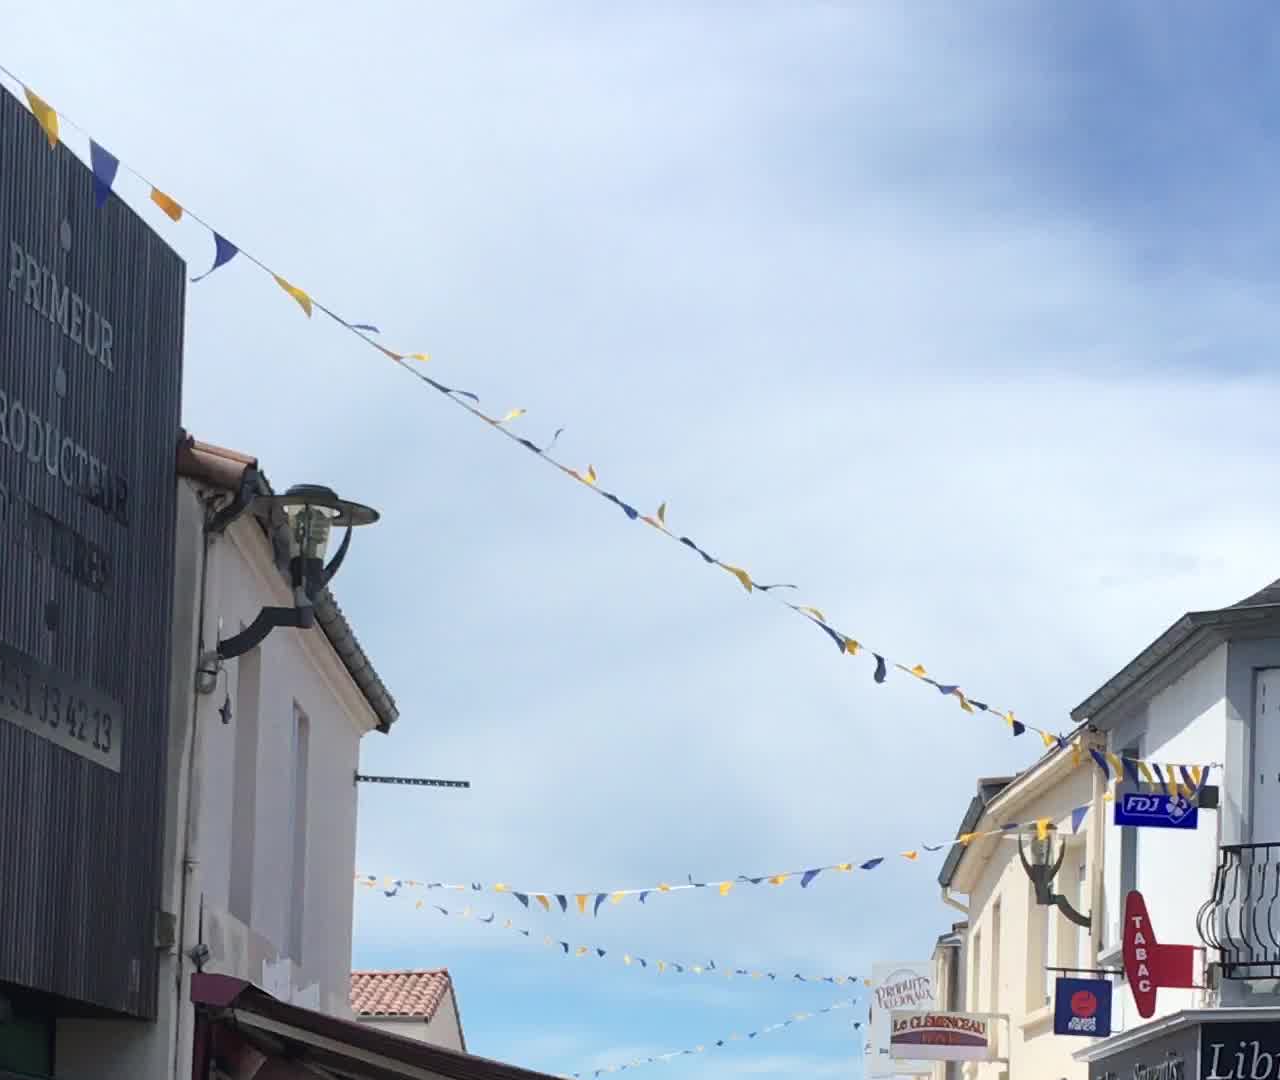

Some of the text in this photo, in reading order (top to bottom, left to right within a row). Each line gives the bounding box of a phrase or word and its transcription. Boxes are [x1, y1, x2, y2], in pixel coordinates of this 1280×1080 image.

[7, 239, 114, 374] PRIMEUR
[1126, 796, 1159, 813] FDJ
[1131, 915, 1152, 993] TABAC
